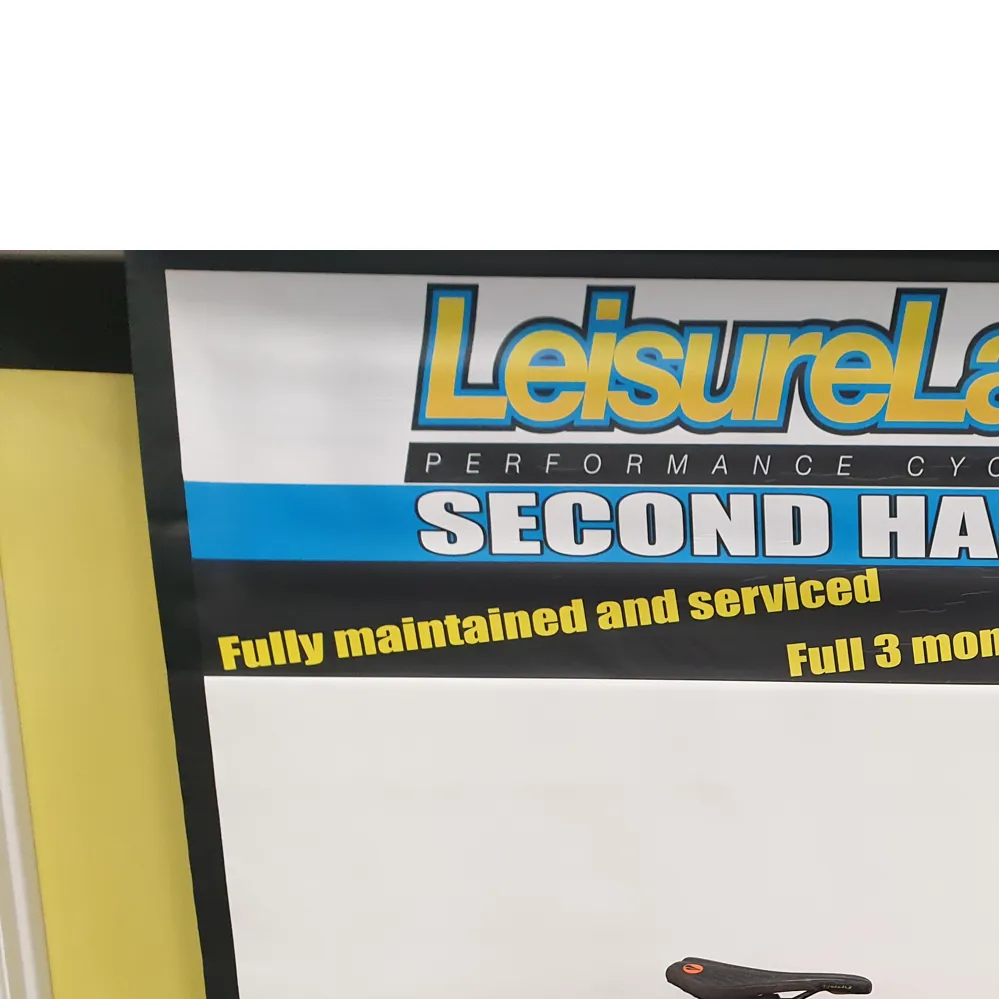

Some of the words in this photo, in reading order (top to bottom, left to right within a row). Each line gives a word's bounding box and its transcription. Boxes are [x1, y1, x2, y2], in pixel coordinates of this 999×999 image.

[424, 452, 855, 478] PERFORMANCE
[416, 490, 832, 558] SECOND
[217, 627, 325, 671] Fully
[333, 598, 588, 659] maintained
[596, 587, 681, 631] and
[687, 567, 882, 620] serviced
[786, 635, 865, 679] Full
[873, 634, 903, 669] 3
